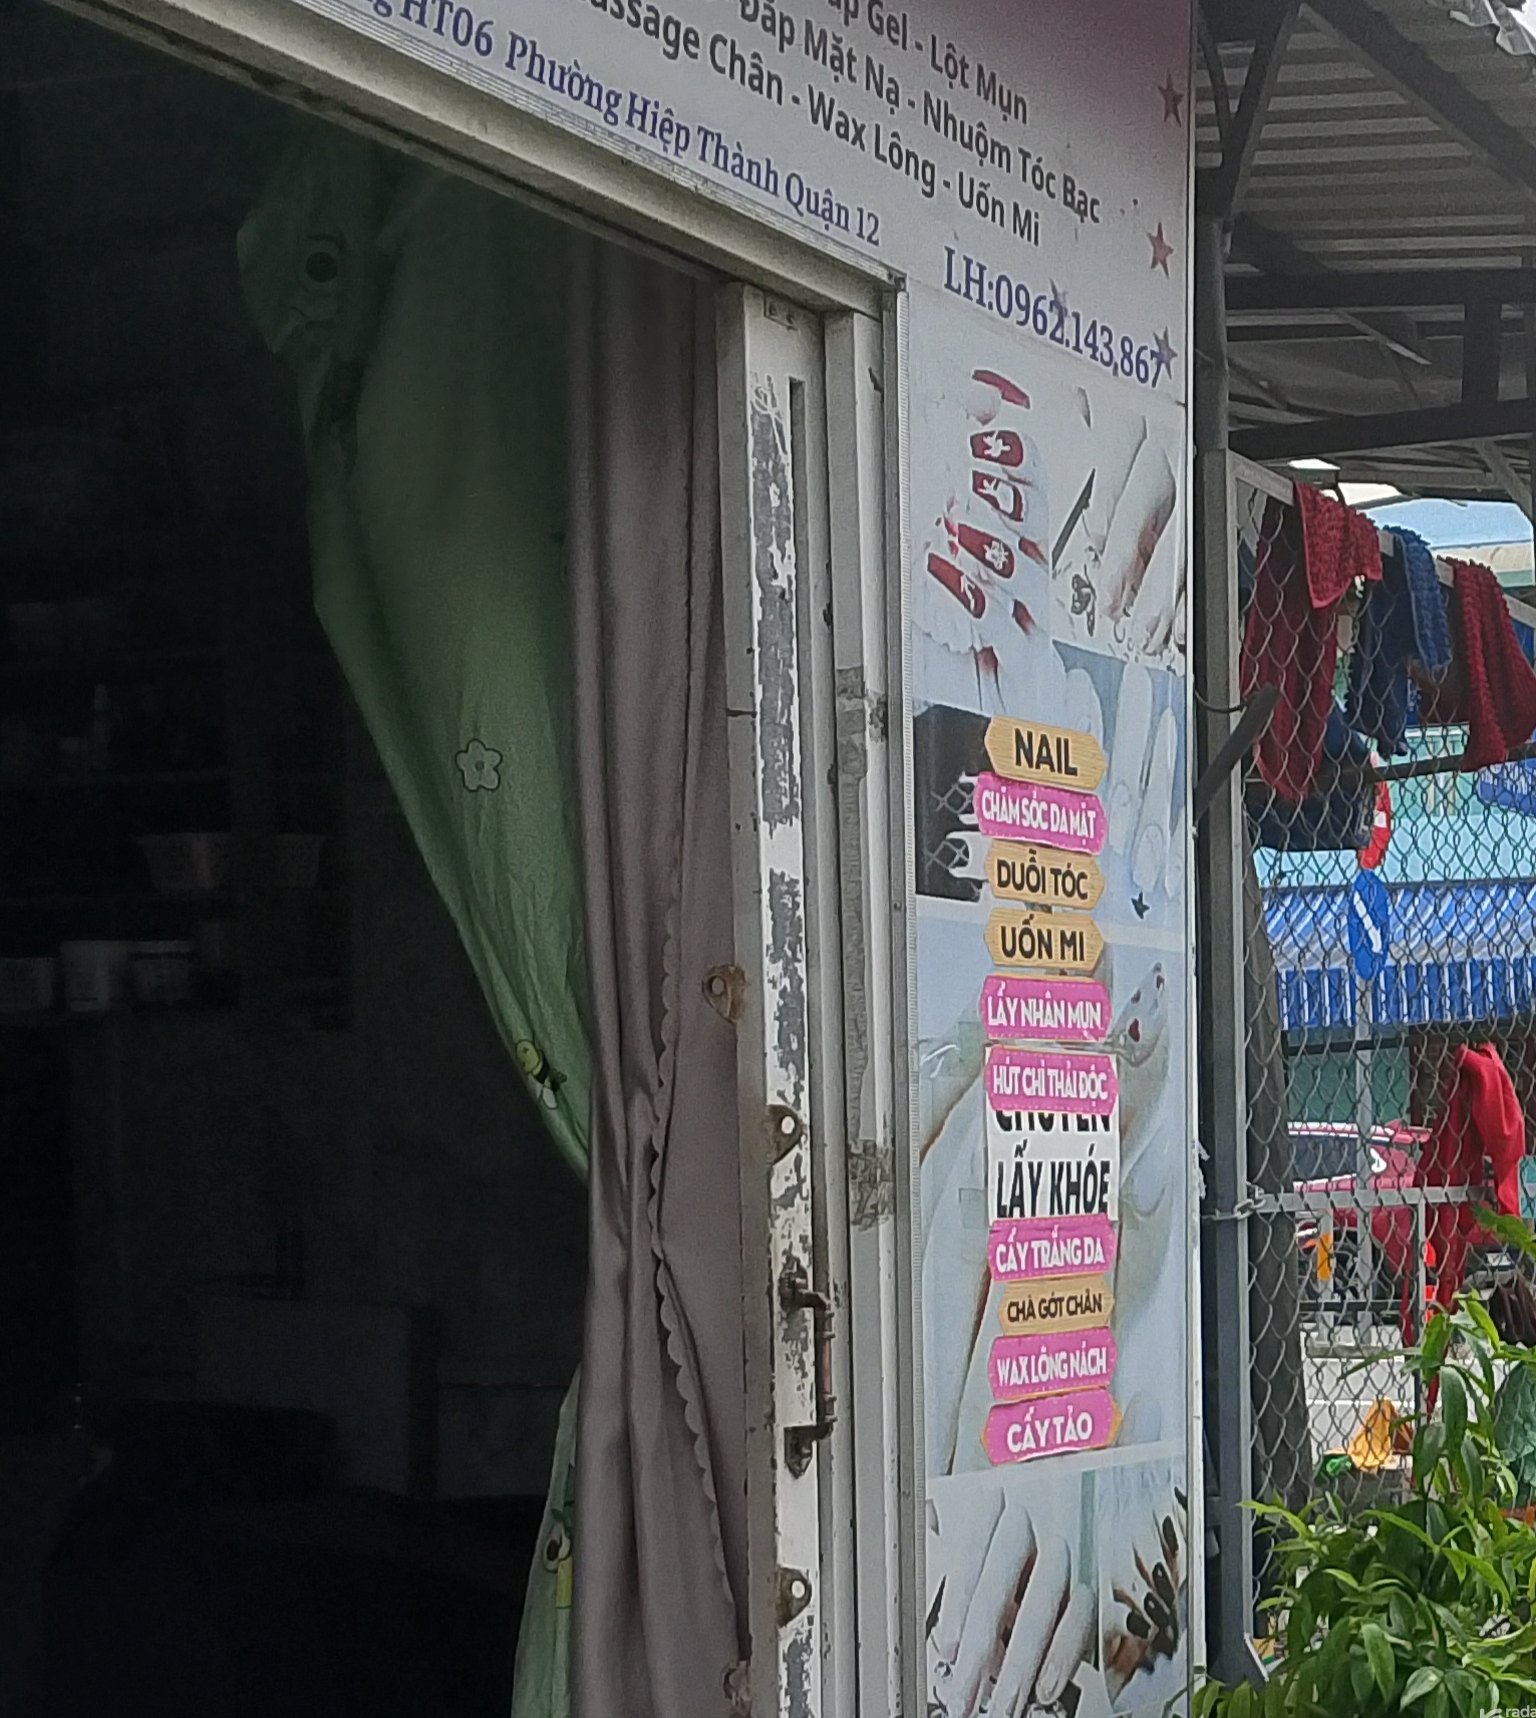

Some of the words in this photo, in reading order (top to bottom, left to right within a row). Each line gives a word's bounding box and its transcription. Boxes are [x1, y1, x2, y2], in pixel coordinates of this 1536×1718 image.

[868, 0, 908, 51] Gel
[931, 34, 970, 89] Lột
[976, 63, 1028, 124] Mụn
[504, 30, 622, 126] Phường
[625, 90, 690, 159] Hiệp
[697, 124, 780, 197] Thành
[785, 172, 850, 231] Quận
[856, 206, 880, 247] 12
[709, 33, 783, 105] Chân
[807, 84, 867, 152] Wax
[874, 123, 936, 199] Lông
[1012, 201, 1040, 247] Mi
[804, 19, 857, 83] Mặt
[865, 55, 900, 115] Nạ
[924, 90, 1012, 173] Nhuộm
[1017, 147, 1056, 200] Tóc
[1062, 172, 1100, 223] Bạc
[1014, 727, 1078, 777] NAIL
[1021, 789, 1049, 831] SÓC
[1050, 803, 1069, 834] DA
[1050, 862, 1089, 900] TÓC
[1000, 913, 1053, 960] UỐN
[1060, 929, 1085, 962] MI
[1020, 990, 1066, 1029] NHÂN
[1067, 1000, 1102, 1037] MỤN
[993, 1056, 1021, 1096] HÚT
[1049, 1143, 1111, 1216] KHÓE
[995, 1227, 1030, 1274] CẤY
[1030, 1224, 1082, 1270] TRẮNG
[1083, 1236, 1106, 1266] DA
[1038, 1291, 1065, 1319] GÓT
[997, 1356, 1029, 1387] WAX
[1030, 1344, 1069, 1383] LÔNG
[1070, 1341, 1107, 1378] NÁCH
[1007, 1406, 1051, 1453] CẤY
[1052, 1405, 1093, 1444] TẢO
